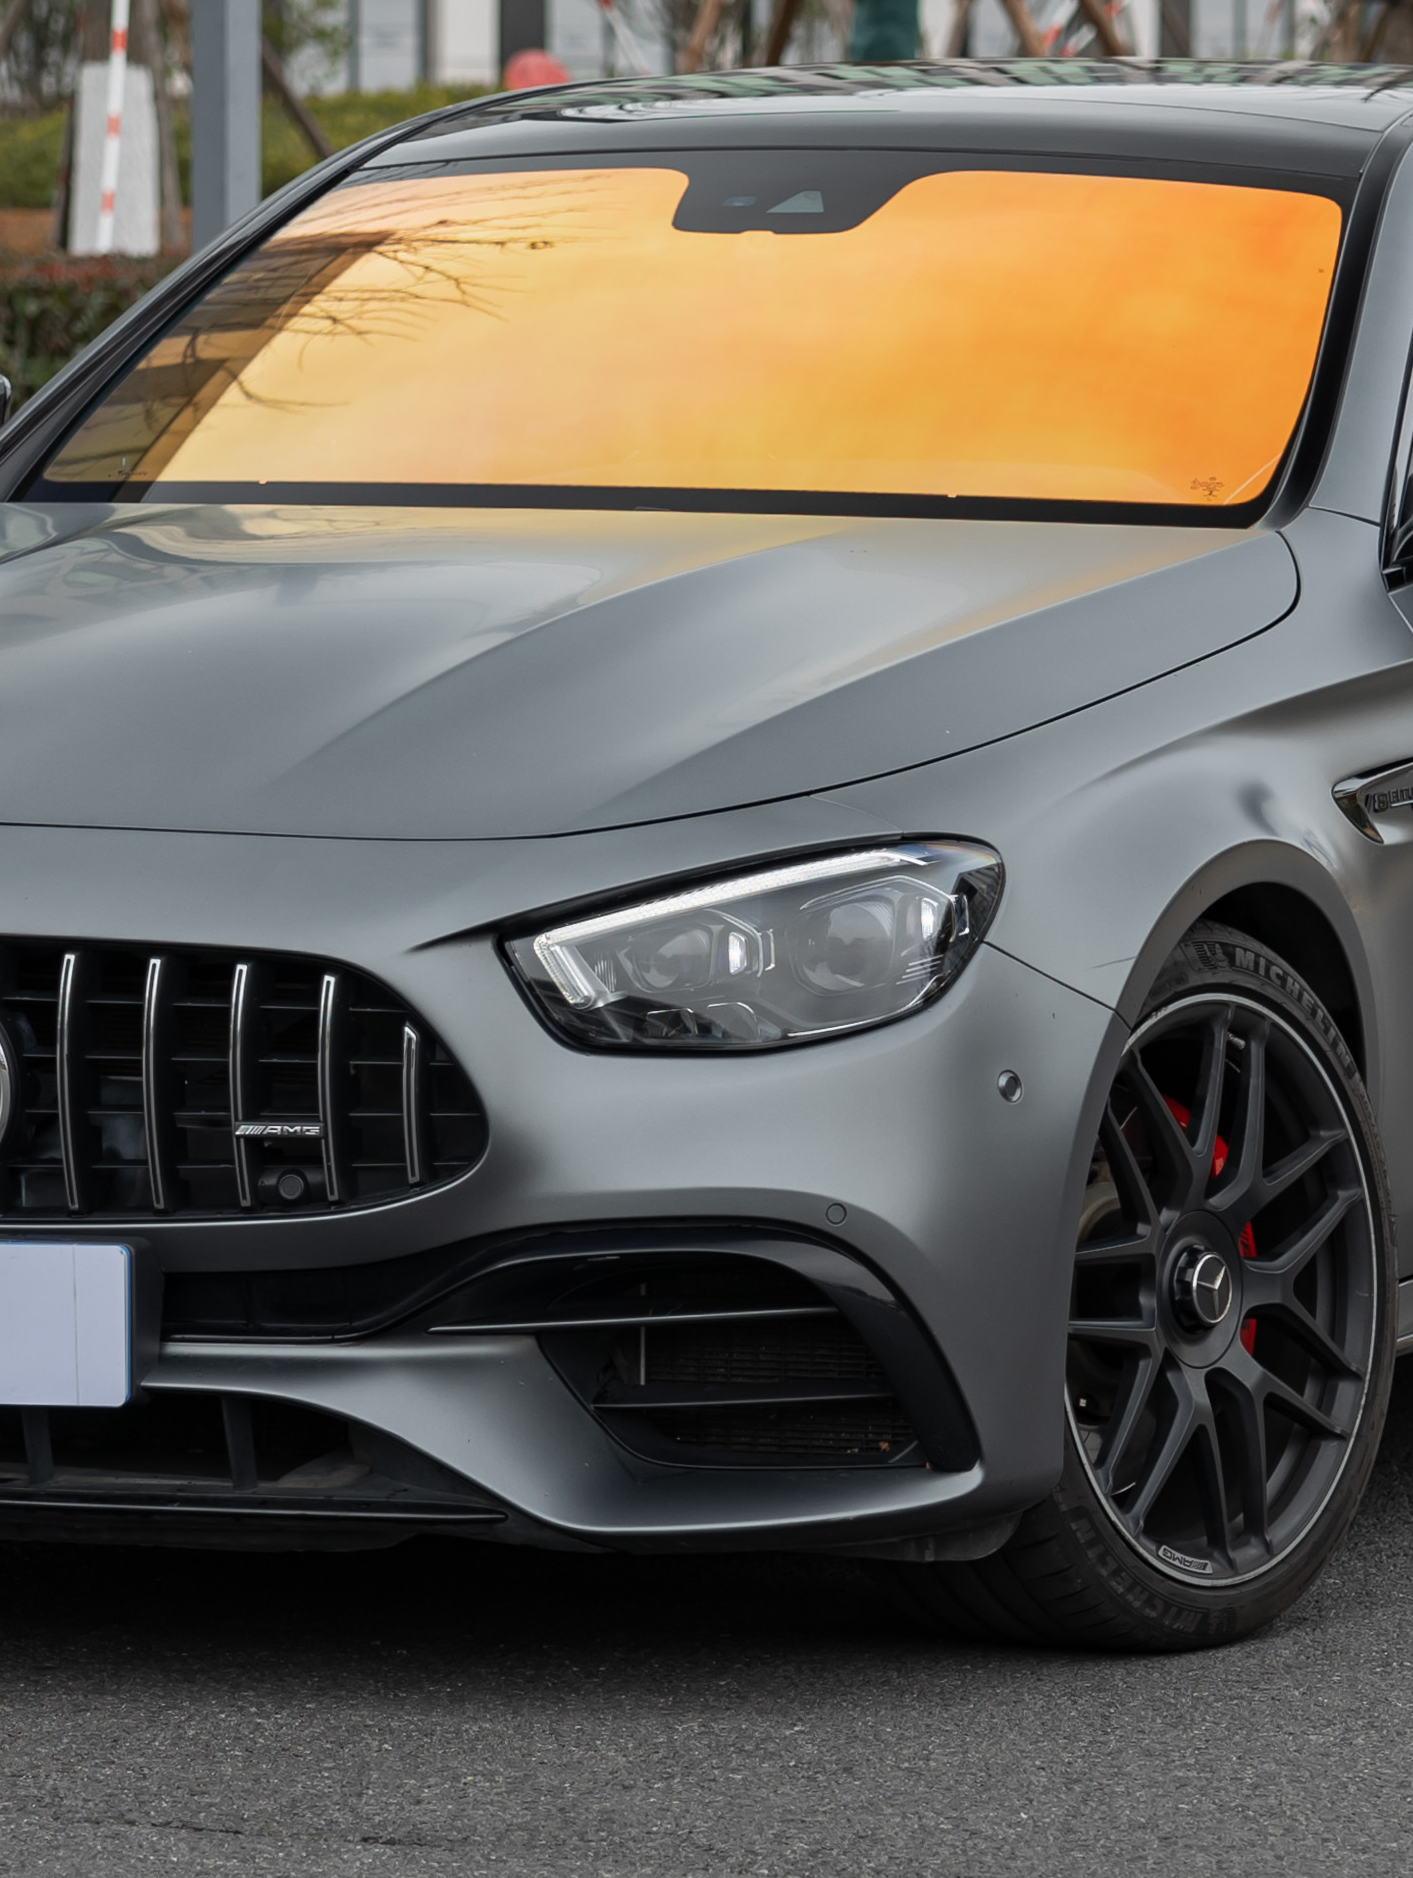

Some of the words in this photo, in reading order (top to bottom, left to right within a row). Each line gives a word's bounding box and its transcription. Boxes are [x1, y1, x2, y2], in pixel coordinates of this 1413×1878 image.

[1234, 946, 1351, 1068] MICHELIN
[262, 1125, 320, 1135] AMG
[1162, 1547, 1194, 1568] AMG
